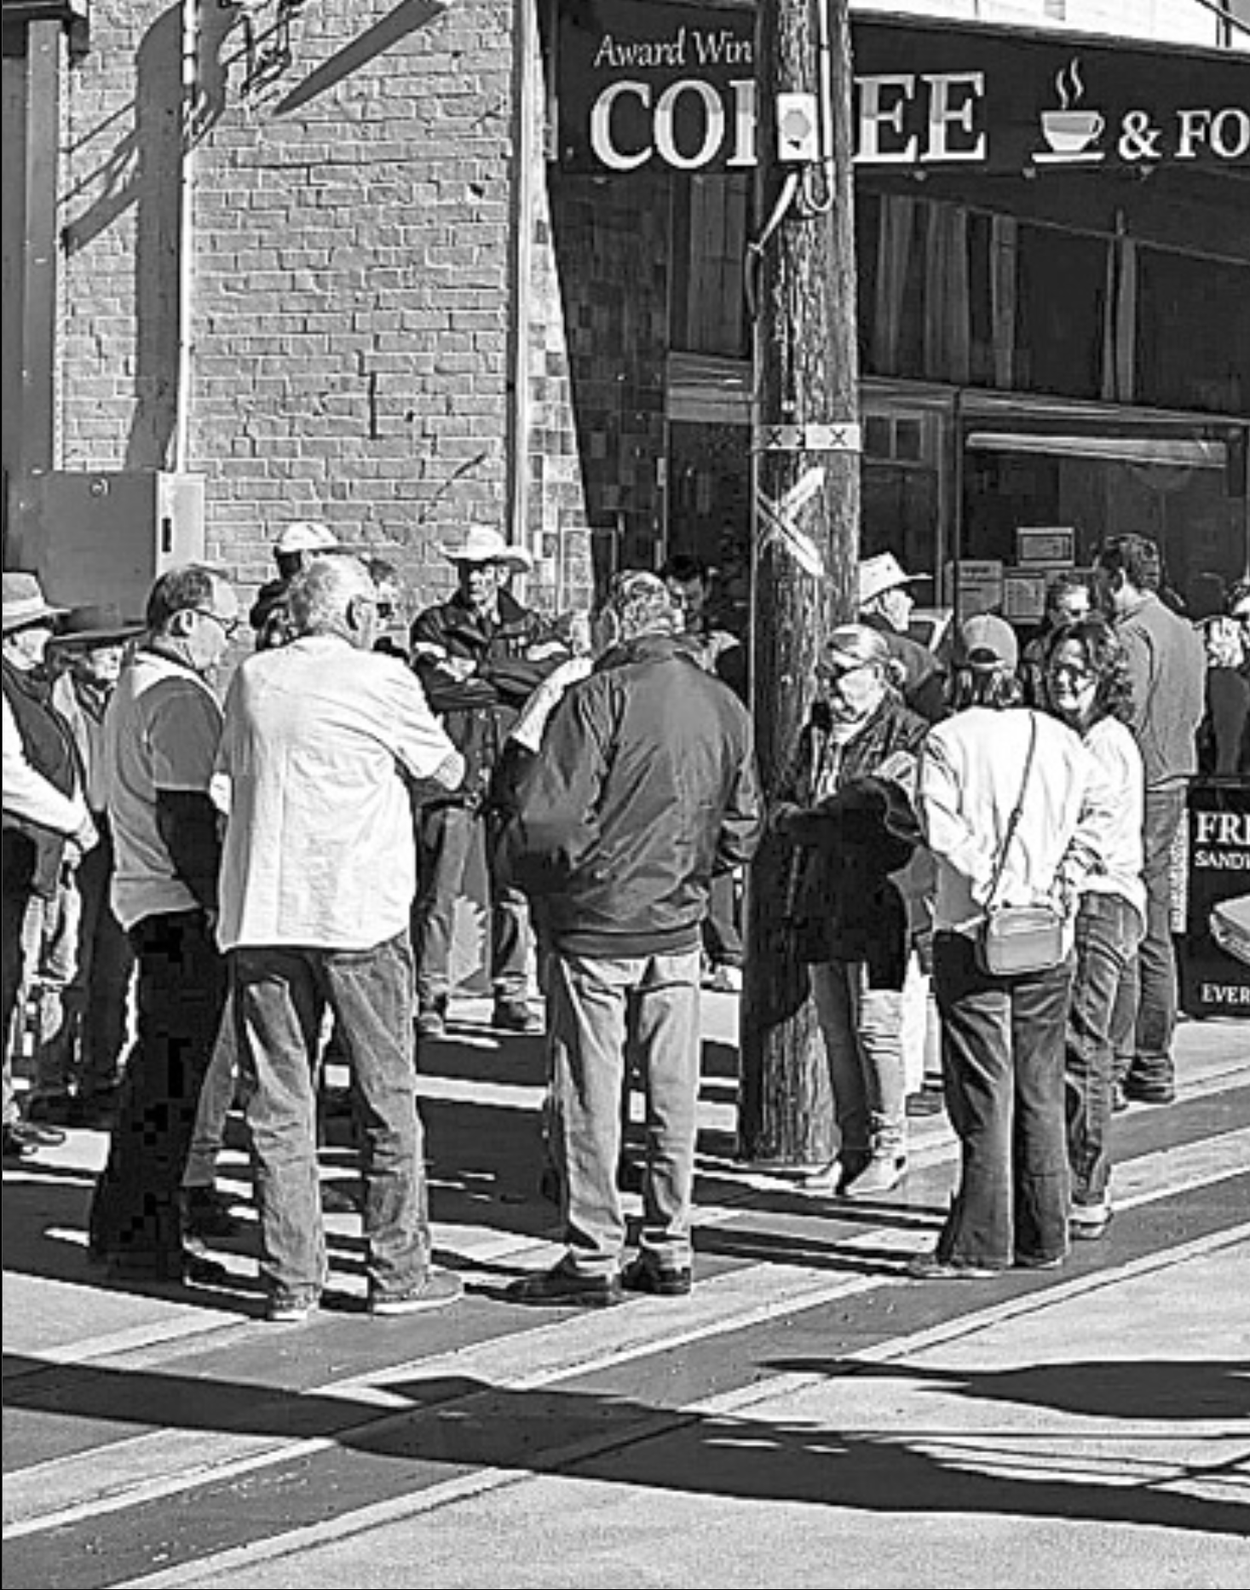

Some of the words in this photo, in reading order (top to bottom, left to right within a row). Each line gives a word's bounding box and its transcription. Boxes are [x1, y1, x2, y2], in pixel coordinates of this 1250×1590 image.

[594, 26, 686, 67] Award
[590, 71, 986, 169] COFEE
[1118, 111, 1162, 160] &
